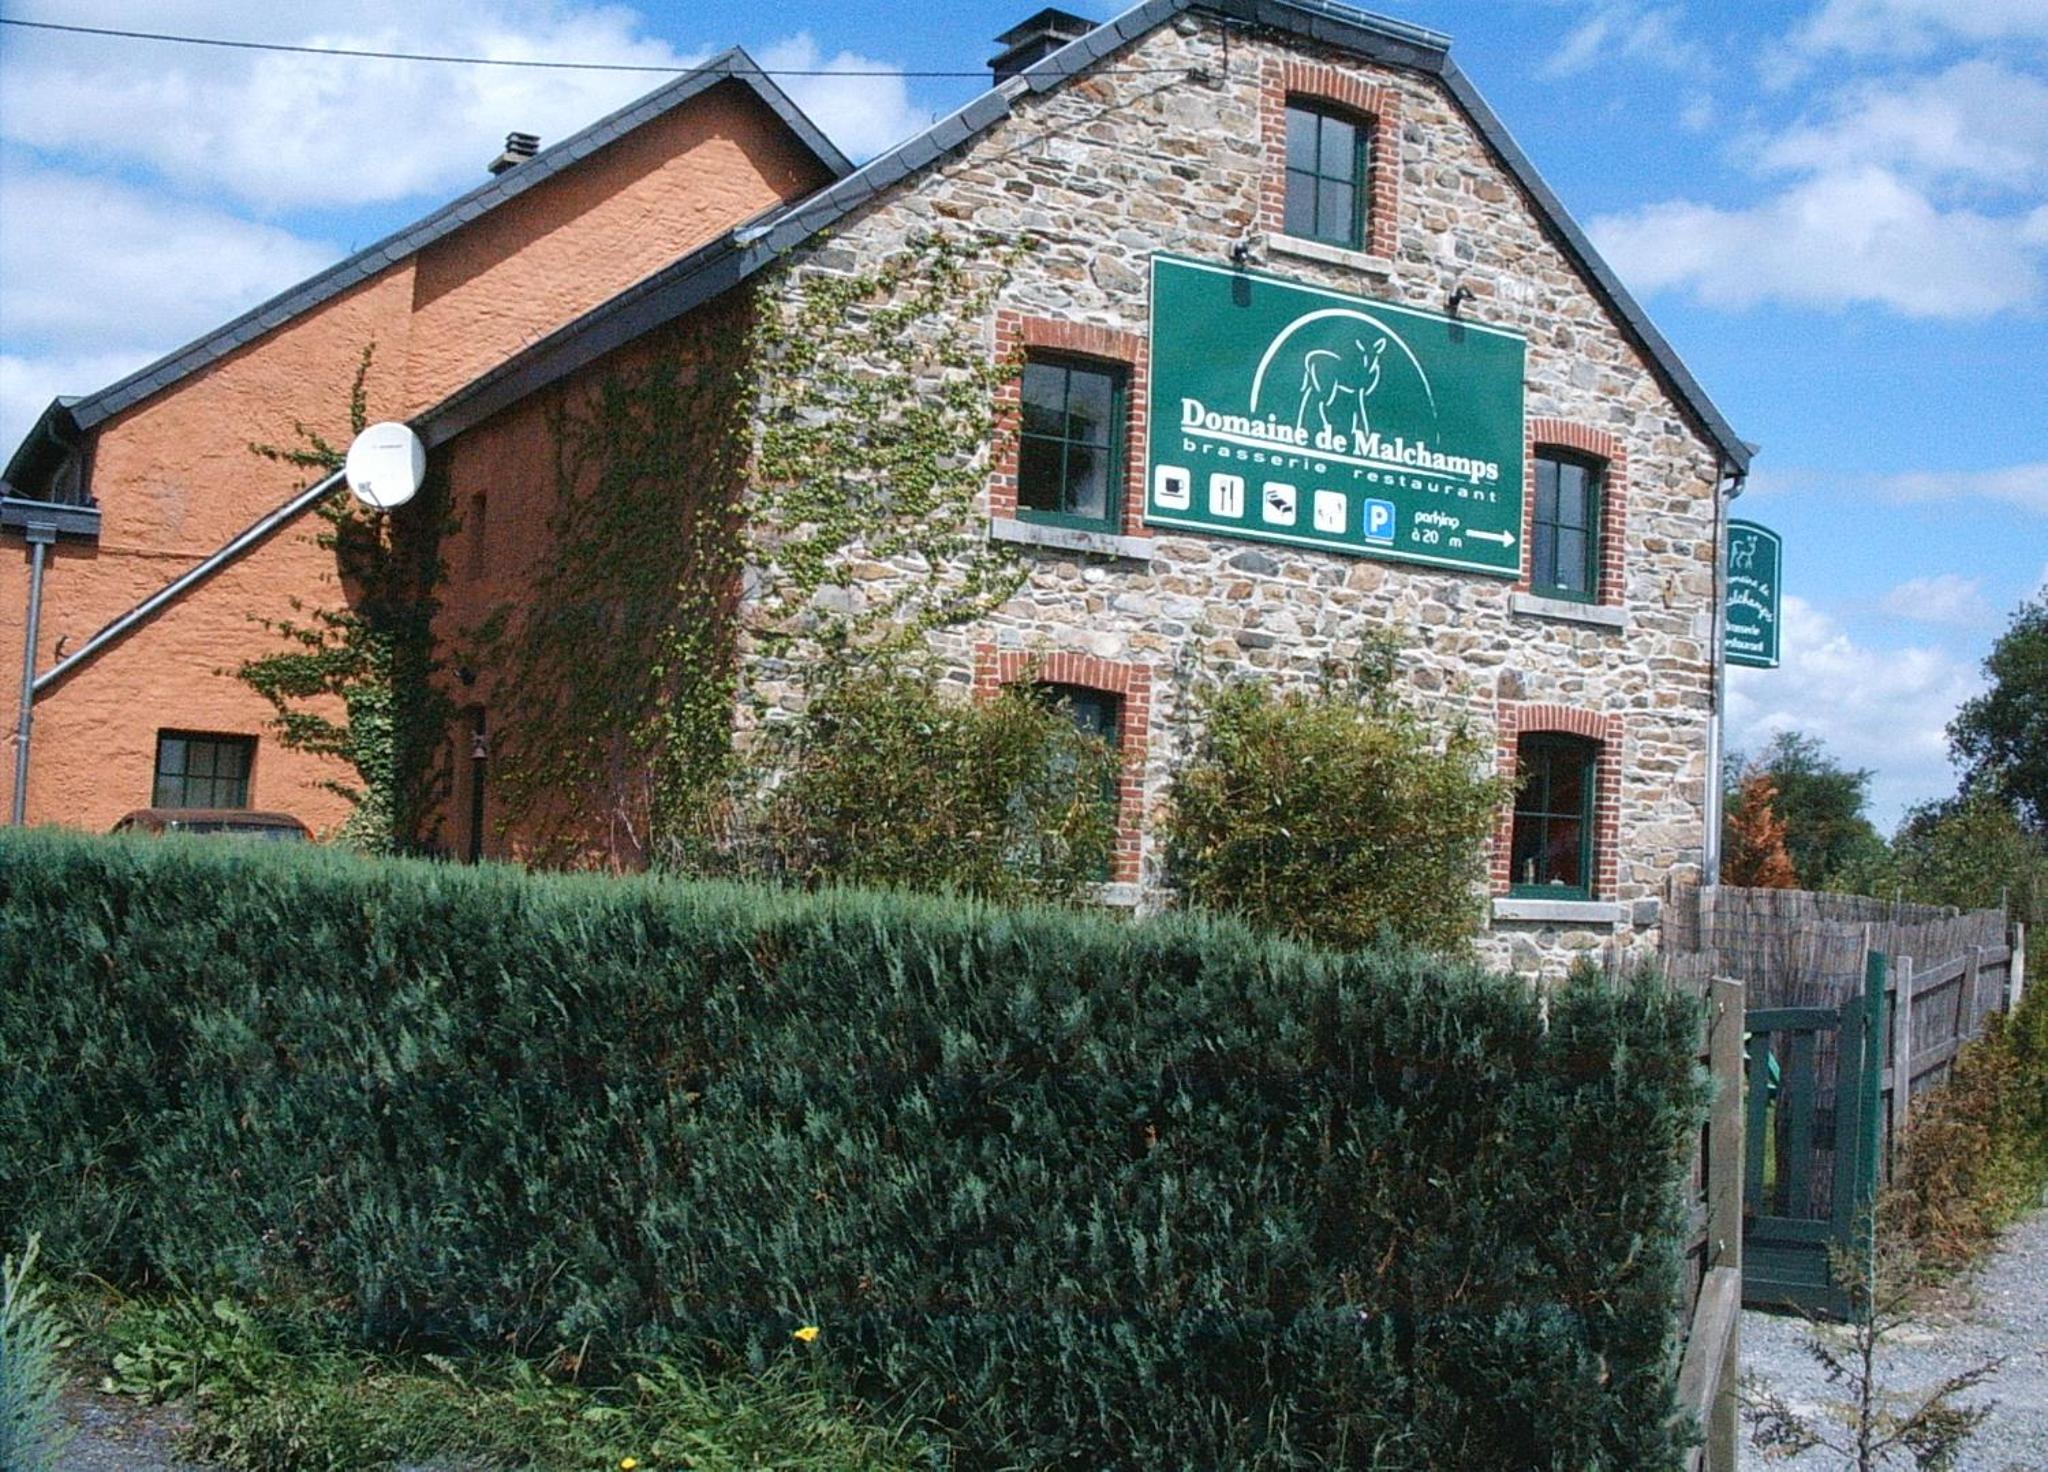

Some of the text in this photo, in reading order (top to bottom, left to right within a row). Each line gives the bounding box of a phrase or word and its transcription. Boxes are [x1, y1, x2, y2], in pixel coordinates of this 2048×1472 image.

[1181, 398, 1499, 484] Domaine de Malchamps
[1183, 439, 1498, 503] brasserie restaurant
[1371, 509, 1388, 530] P
[1423, 529, 1440, 545] 20
[1449, 537, 1462, 548] m
